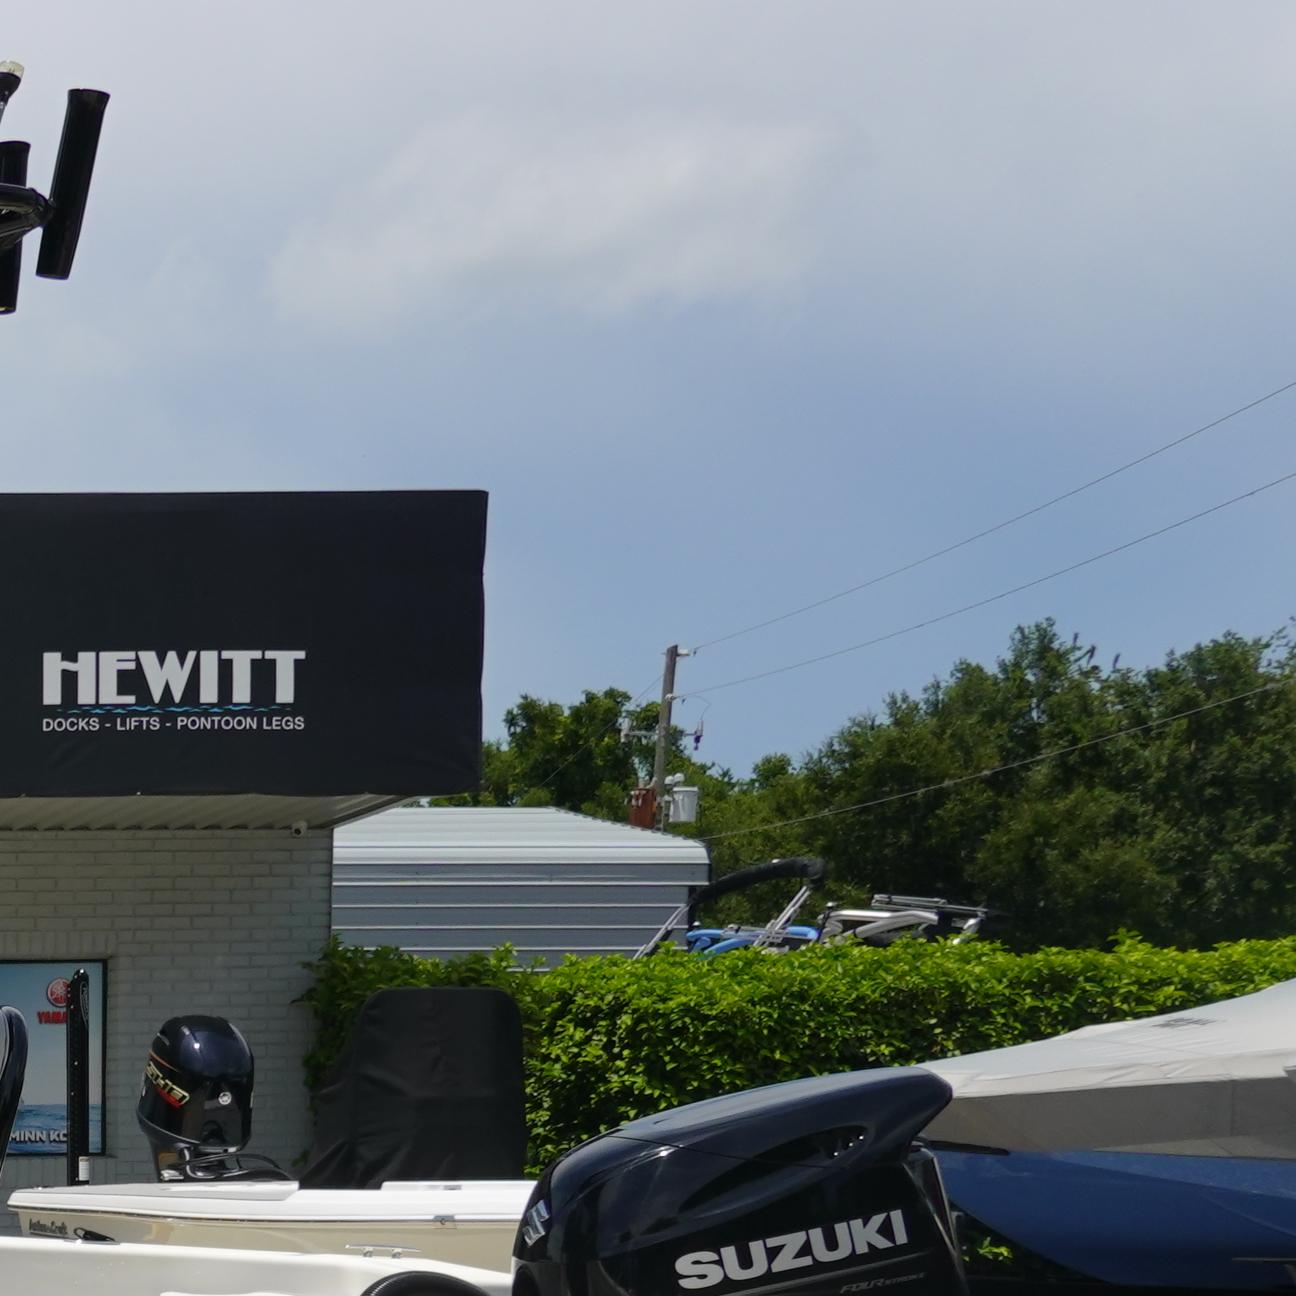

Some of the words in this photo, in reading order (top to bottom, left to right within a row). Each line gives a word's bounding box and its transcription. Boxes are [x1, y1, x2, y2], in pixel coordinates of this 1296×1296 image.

[42, 650, 306, 705] HEWITT
[42, 718, 100, 732] DOCKS
[116, 717, 160, 731] LIFTS
[177, 716, 257, 730] PONTOON
[262, 716, 304, 730] LEGS
[9, 1130, 46, 1143] MINN
[674, 1209, 908, 1290] SUZUKI
